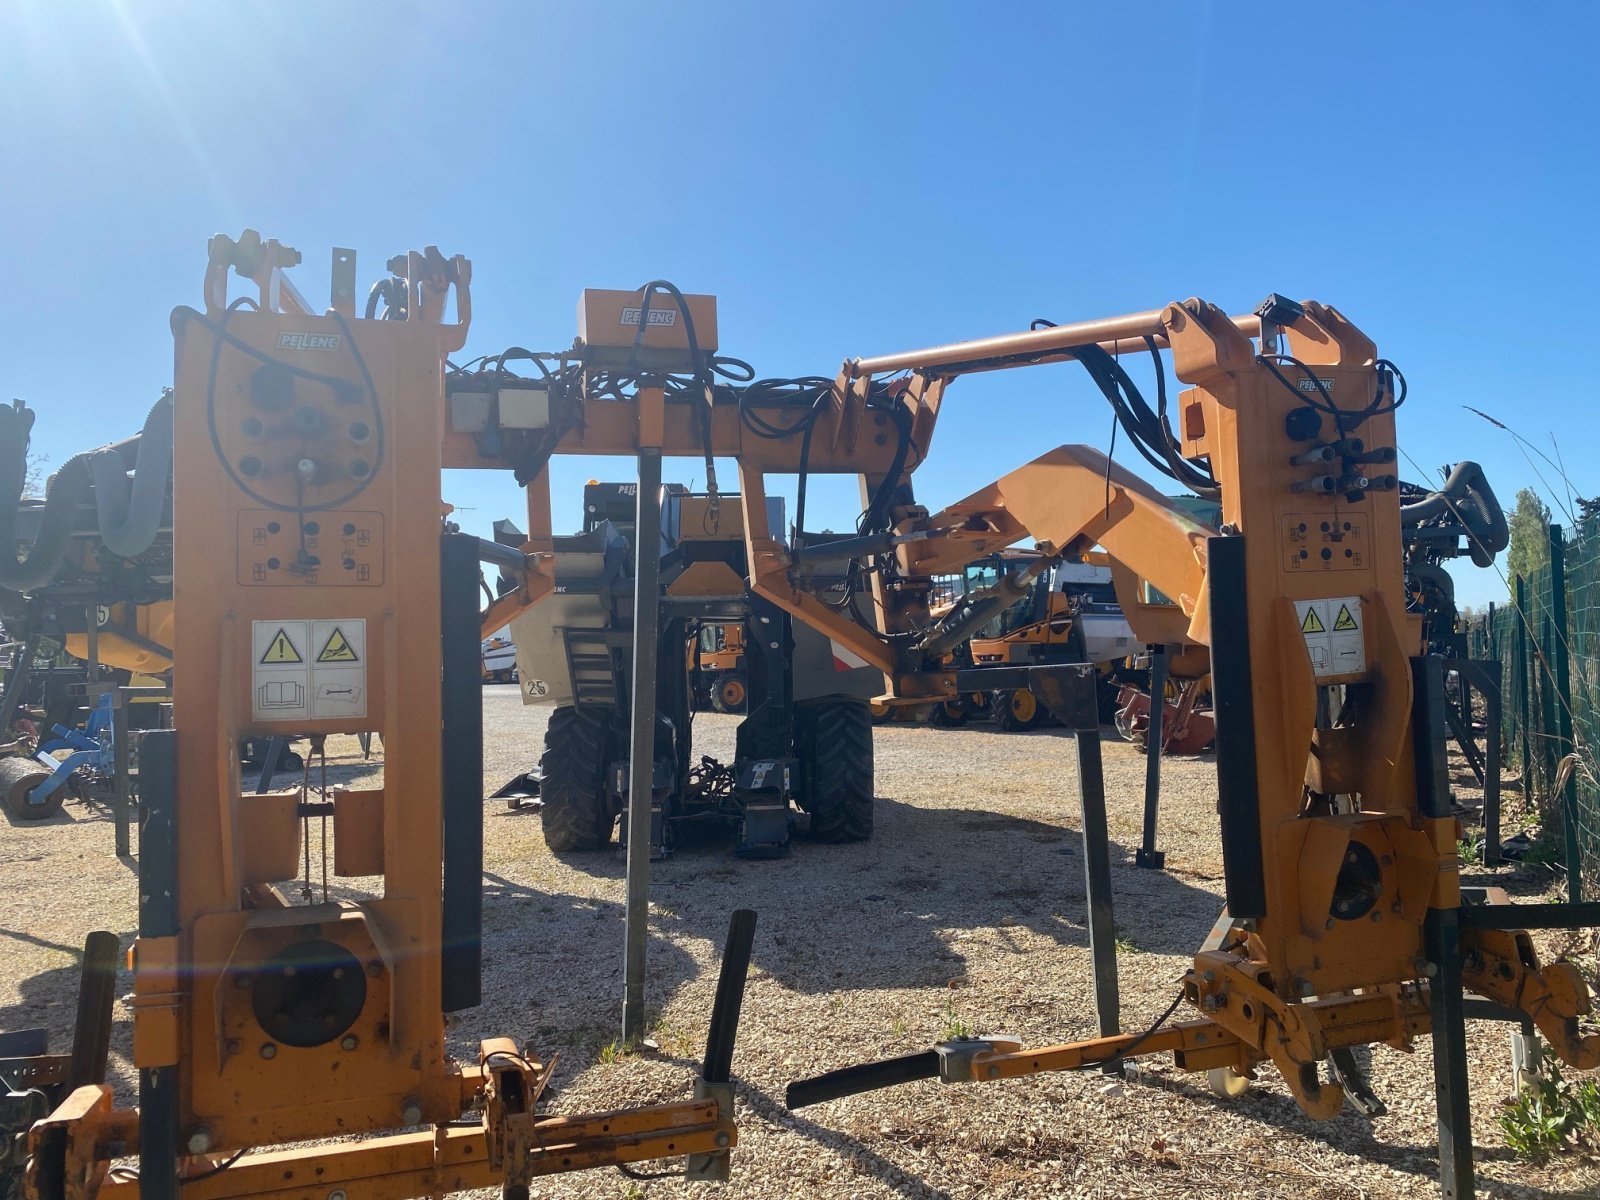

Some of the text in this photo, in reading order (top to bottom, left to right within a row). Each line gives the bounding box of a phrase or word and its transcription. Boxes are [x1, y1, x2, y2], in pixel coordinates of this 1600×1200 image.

[624, 310, 673, 325] PEENC
[280, 332, 338, 350] PELLENC
[528, 681, 546, 695] 25
